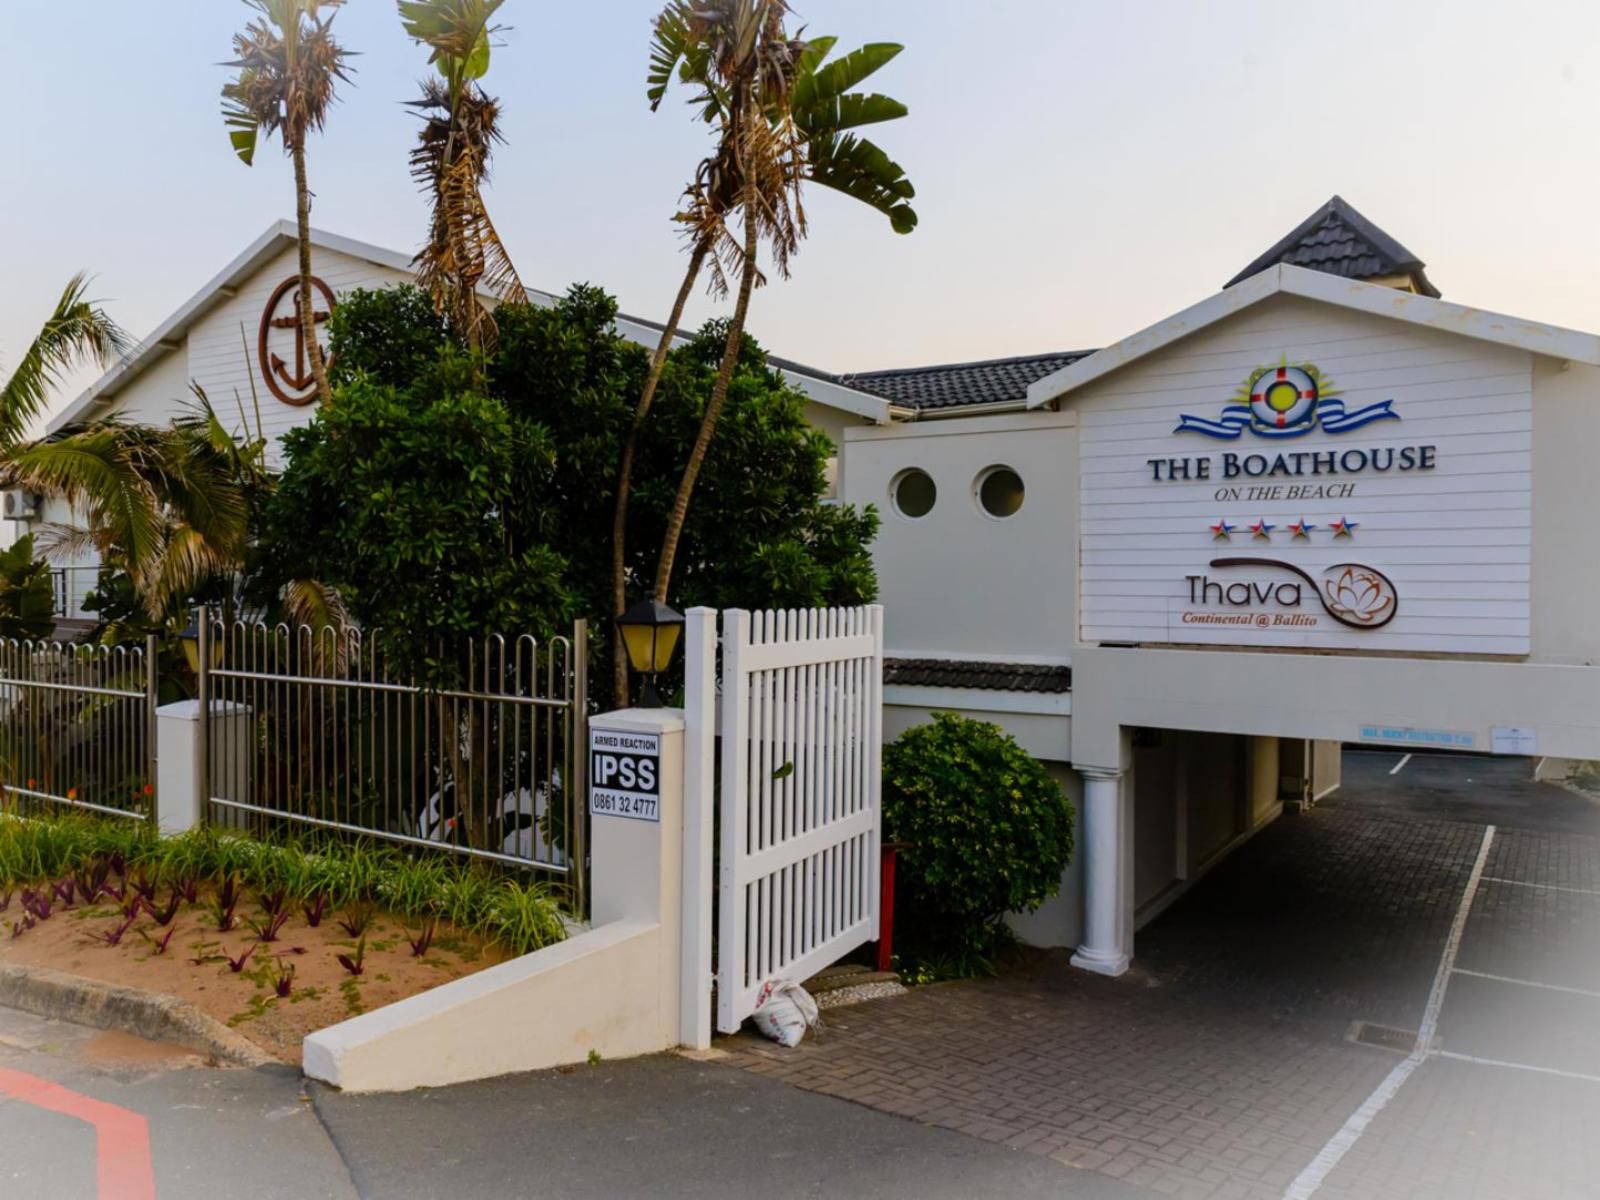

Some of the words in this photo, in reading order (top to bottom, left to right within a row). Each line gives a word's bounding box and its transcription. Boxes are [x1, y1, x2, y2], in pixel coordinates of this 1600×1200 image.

[1147, 457, 1210, 481] THE
[1221, 445, 1437, 479] BOATHOUSE
[1214, 487, 1243, 501] ON
[1247, 485, 1281, 500] THE
[1286, 483, 1356, 499] BEACH
[1185, 575, 1301, 606] Thava
[1182, 612, 1254, 625] Continental
[1272, 613, 1318, 626] Ballito
[594, 735, 618, 747] ARMED
[620, 737, 656, 751] REACTION
[594, 754, 656, 790] IPSS
[594, 793, 616, 811] 0861
[619, 796, 631, 813] 32
[633, 798, 657, 816] 4777
